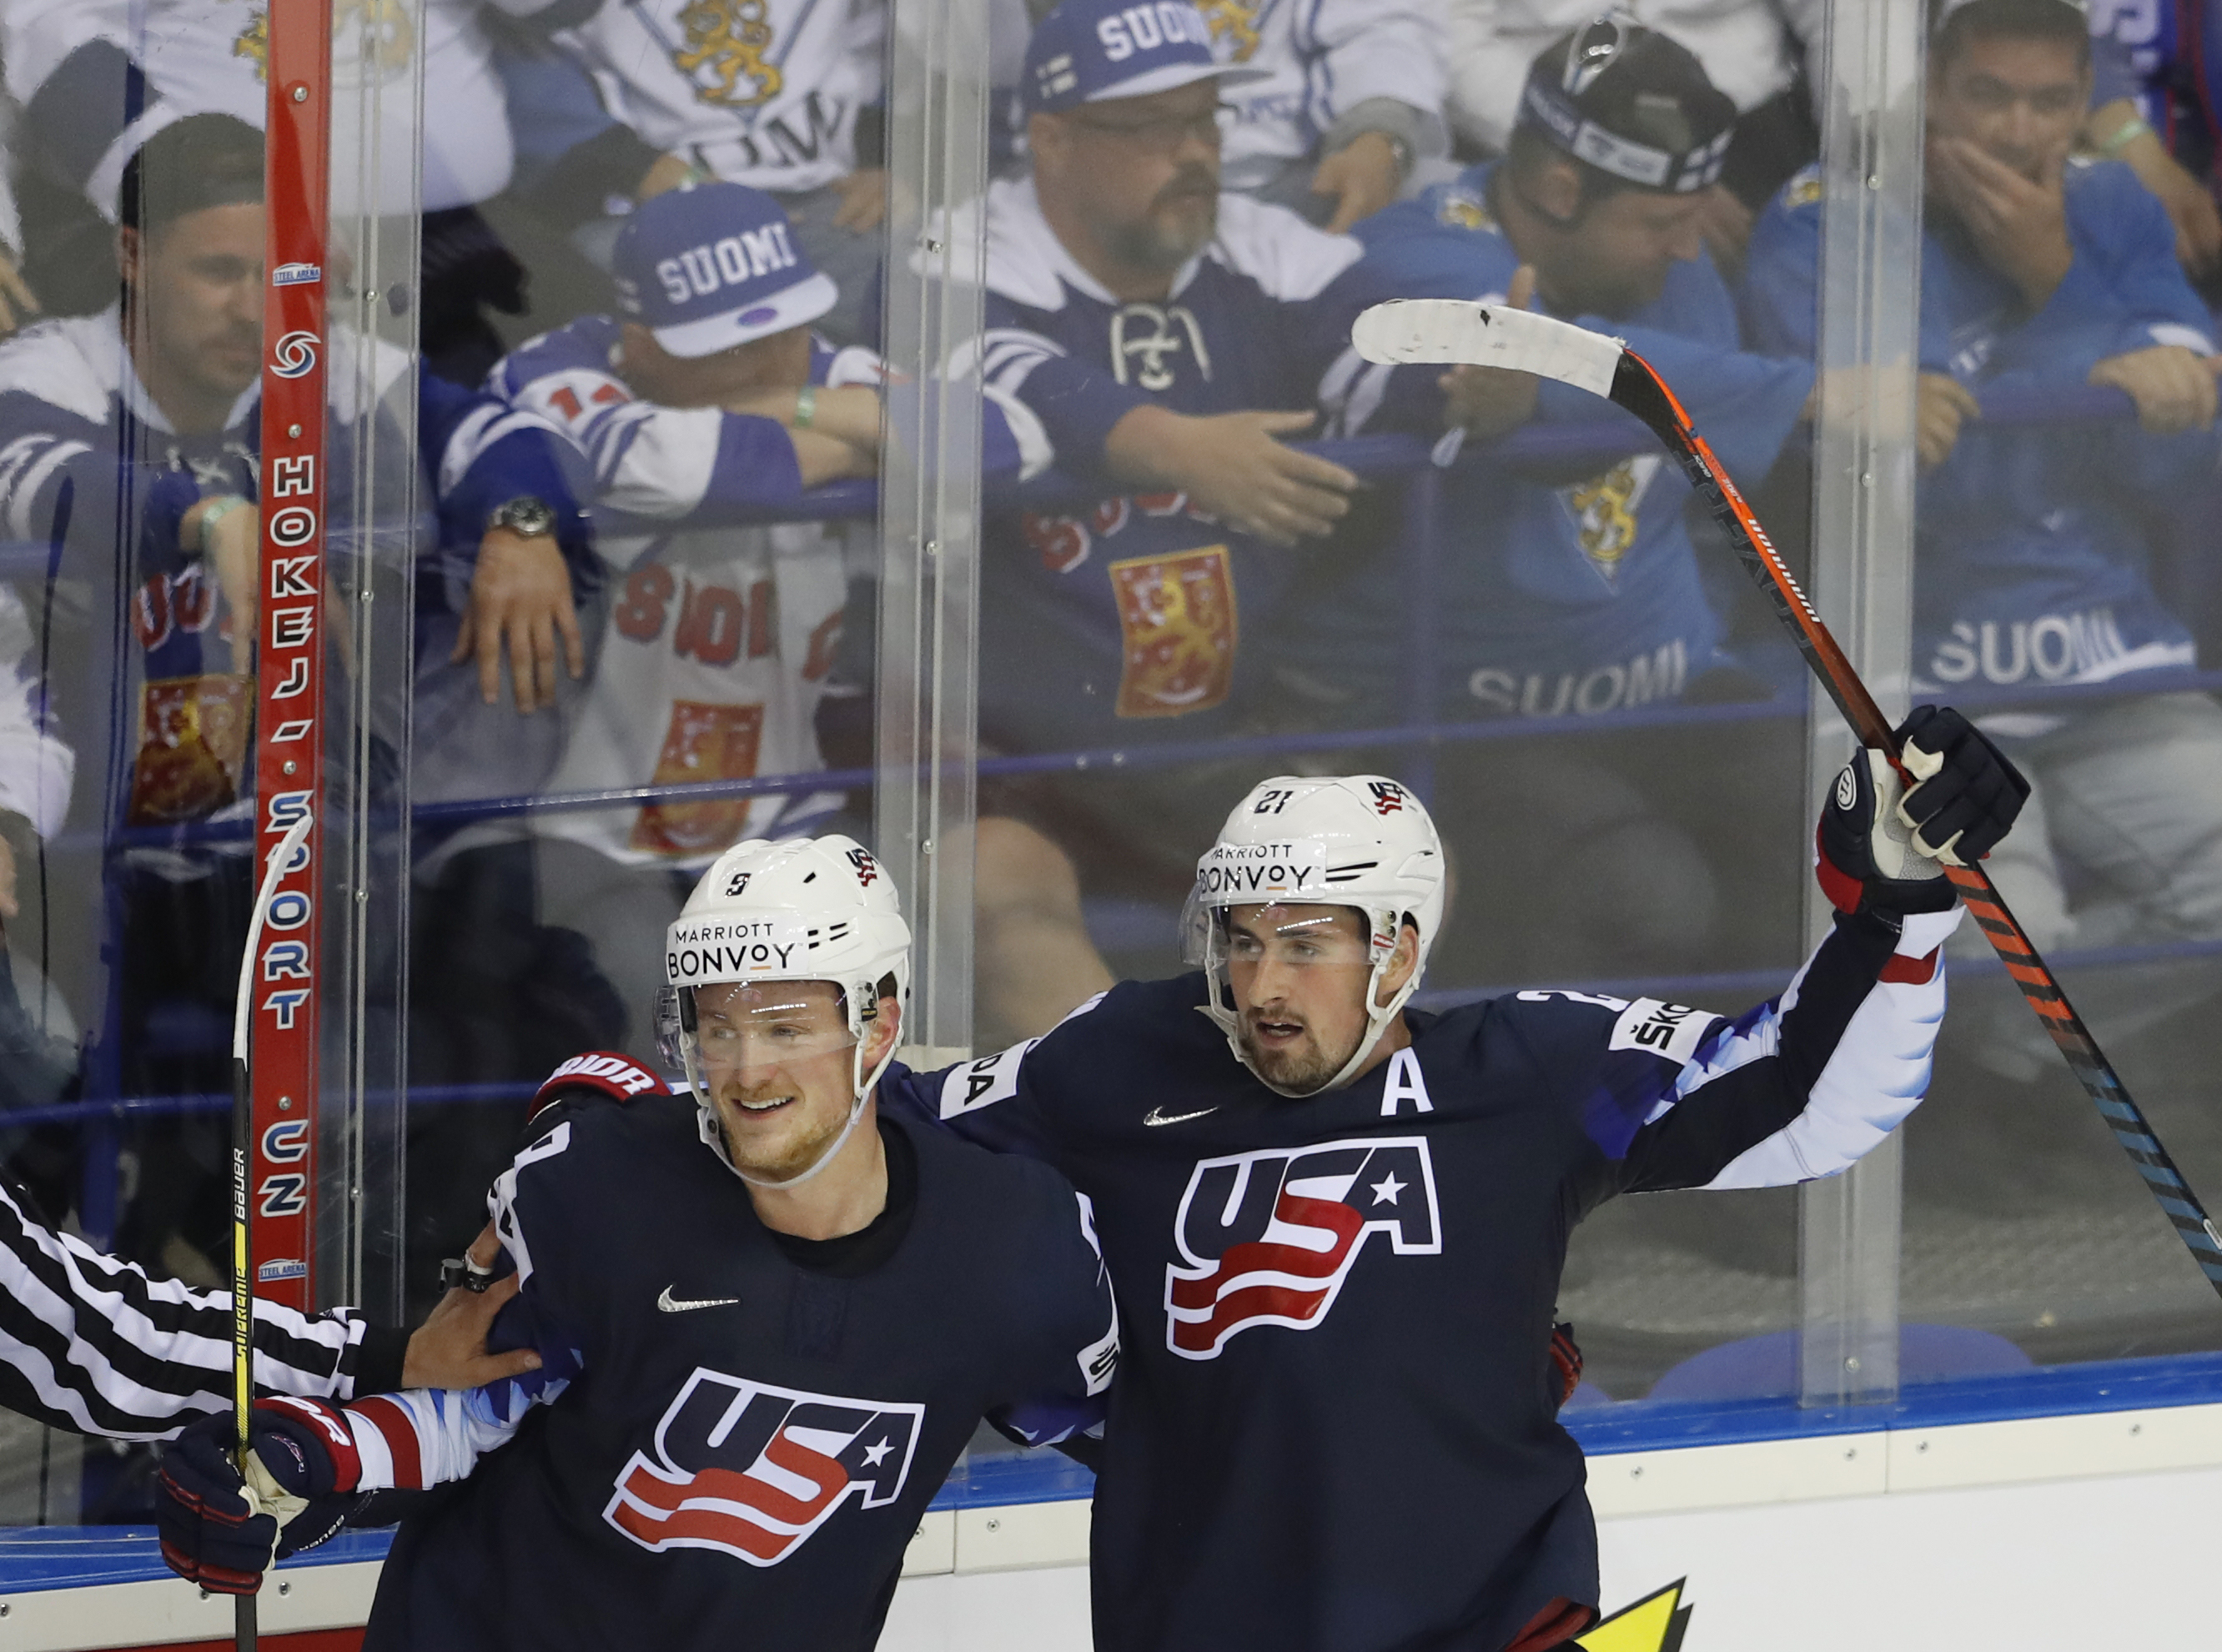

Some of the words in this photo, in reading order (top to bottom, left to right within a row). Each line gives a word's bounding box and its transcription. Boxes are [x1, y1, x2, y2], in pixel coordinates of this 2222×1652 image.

[1097, 2, 1211, 63] SUO
[274, 270, 294, 282] STEEL
[297, 269, 319, 279] ARENA
[656, 221, 797, 304] SUOMI
[1468, 636, 1688, 718] SUOMI
[1254, 790, 1294, 814] 21
[725, 872, 752, 897] 9
[676, 923, 773, 944] MARRIOTT
[668, 942, 796, 979] BONVOY
[1380, 1047, 1433, 1116] A
[259, 1267, 280, 1277] STEEL
[282, 1263, 305, 1274] ARENA
[1164, 1136, 1443, 1361] USA
[601, 1366, 926, 1567] USA
